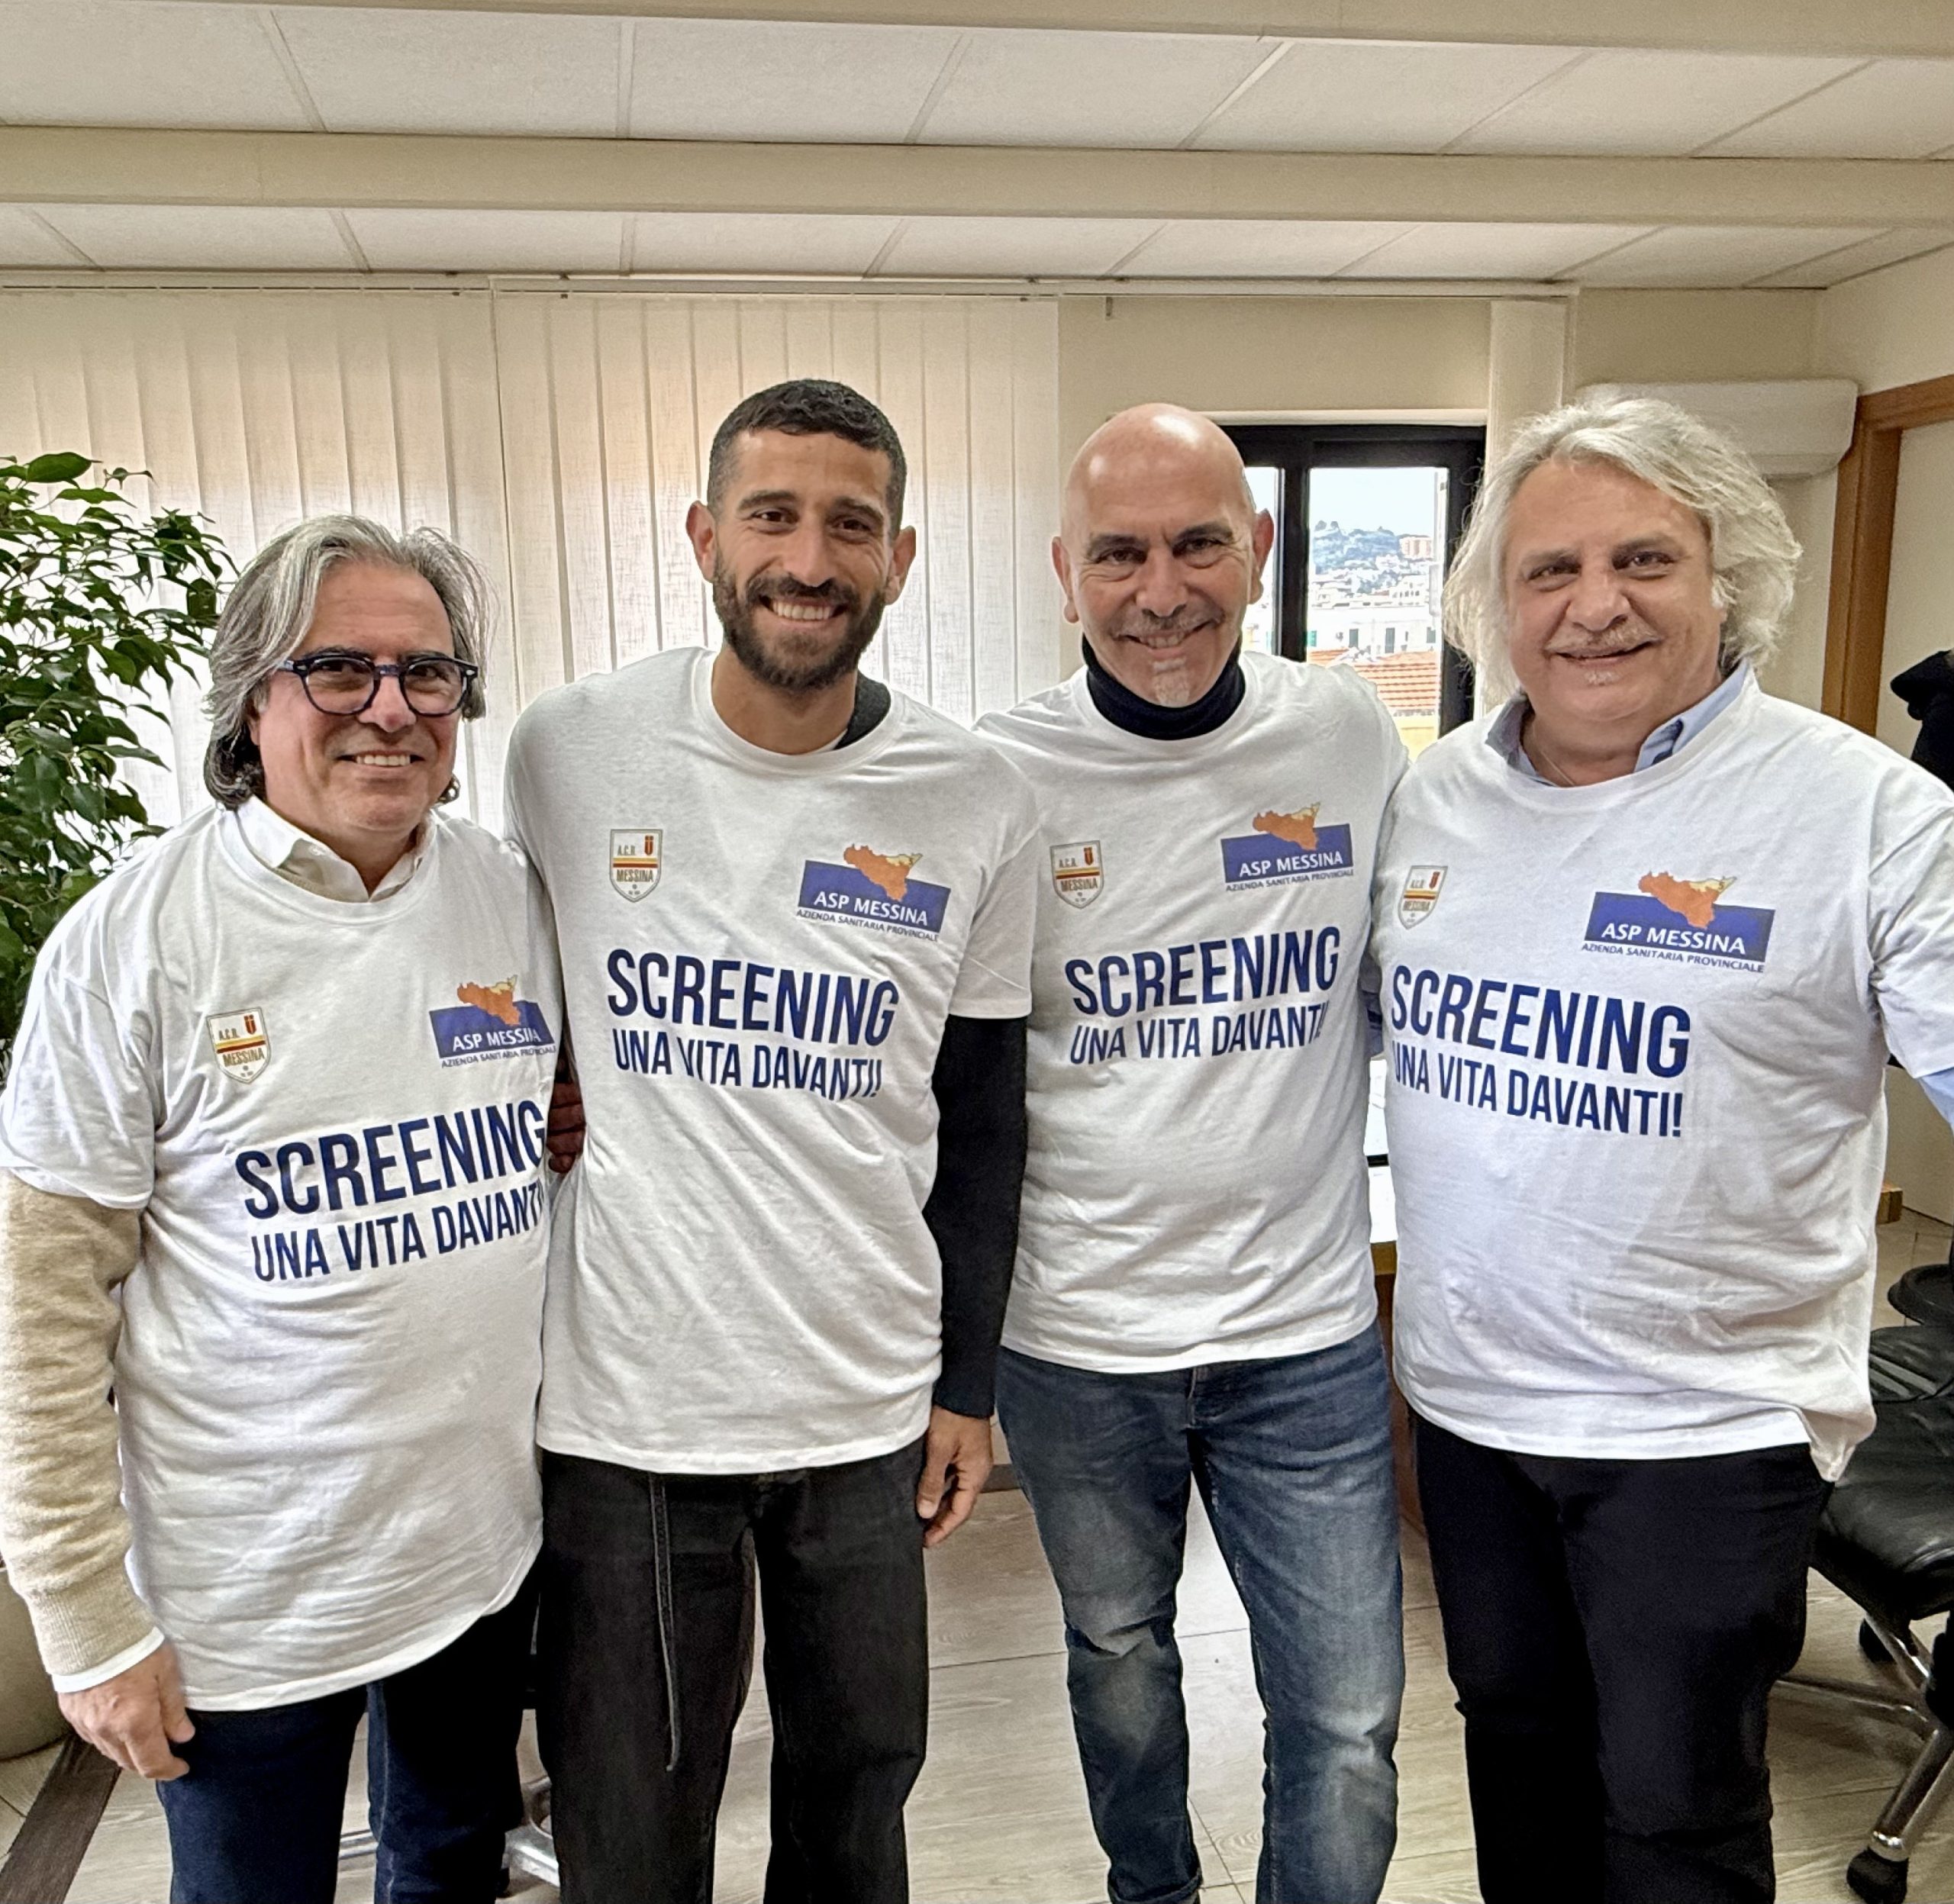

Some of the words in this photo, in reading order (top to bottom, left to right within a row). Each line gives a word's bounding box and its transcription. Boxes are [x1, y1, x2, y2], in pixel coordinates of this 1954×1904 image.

[616, 869, 653, 882] MESSINA
[1239, 860, 1271, 878] ASP
[1276, 851, 1343, 872] MESSINA
[1060, 878, 1098, 892] MESSINA
[1226, 881, 1264, 891] AZIENDA
[1266, 875, 1310, 888] SANITARIA
[814, 891, 850, 910] ASP
[854, 897, 928, 926] MESSINA
[796, 909, 836, 923] AZIENDA
[838, 916, 885, 931] SANITARIA
[887, 925, 939, 942] PROVINCIALE
[1601, 923, 1642, 940] ASP
[1646, 927, 1746, 955] MESSINA
[1064, 926, 1340, 1017] SCREENING
[1582, 942, 1623, 954] AZIENDA
[1626, 947, 1683, 962] SANITARIA
[1687, 955, 1765, 973] PROVINCIALE
[608, 949, 899, 1046] SCREENING
[1391, 965, 1691, 1078] SCREENING
[222, 1048, 265, 1067] MESSINA
[441, 1056, 479, 1068] AZIENDA
[480, 1050, 519, 1062] SANITARIA
[521, 1045, 556, 1057] PROCIALE
[453, 1033, 482, 1052] ASP
[1070, 1026, 1127, 1065] UNA
[1137, 1017, 1201, 1058] VITA
[612, 1028, 672, 1075] UNA
[676, 1036, 741, 1087] VITA
[752, 1044, 882, 1101] DAVANTI!
[1438, 1052, 1498, 1112] VITA
[1507, 1069, 1685, 1138] DAVANTI!
[235, 1100, 546, 1219] SCREENING
[251, 1227, 331, 1282] UNA
[337, 1212, 427, 1271] VITA
